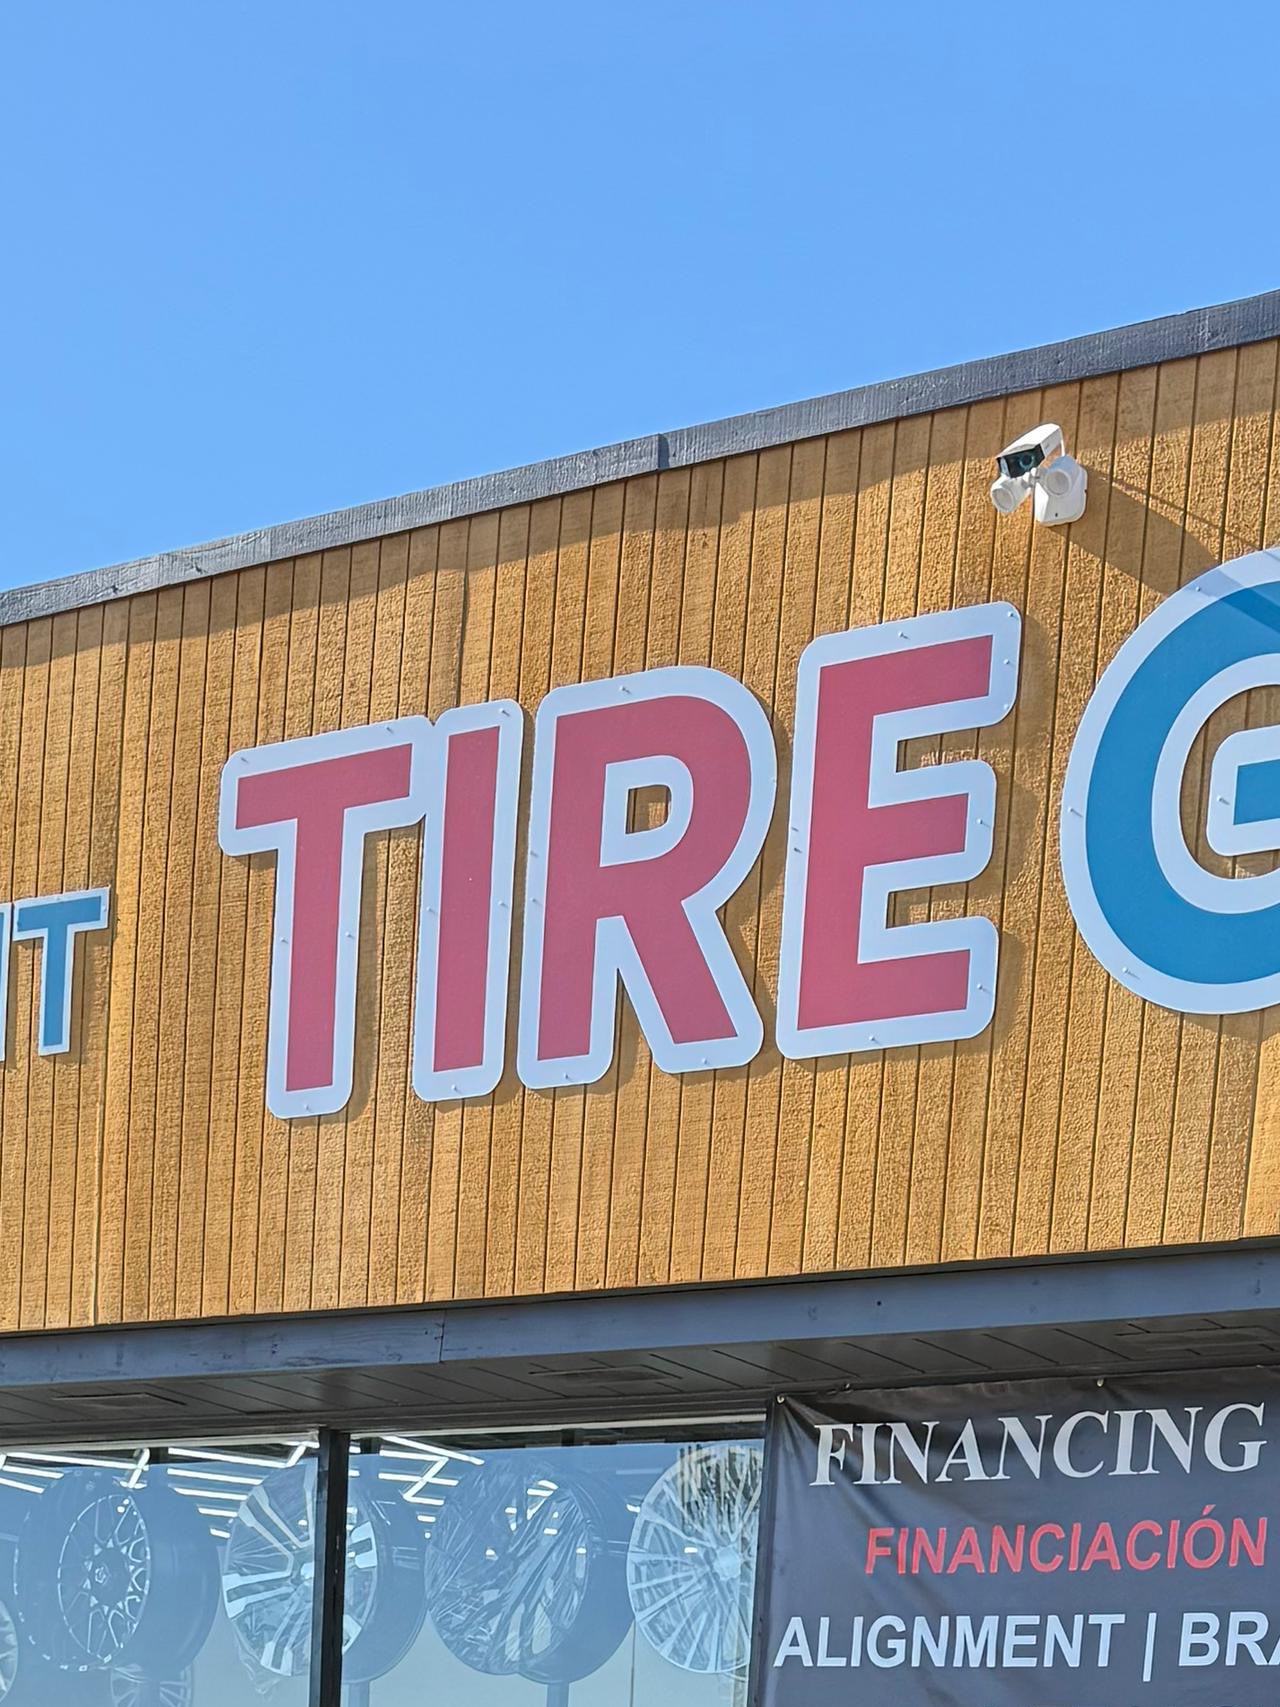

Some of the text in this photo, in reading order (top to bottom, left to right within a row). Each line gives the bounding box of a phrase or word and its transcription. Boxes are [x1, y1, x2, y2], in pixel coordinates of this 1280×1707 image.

[219, 599, 1024, 1120] TIRE
[811, 1401, 1266, 1488] FINANCING
[864, 1505, 1269, 1575] FINANCIACIÓN
[773, 1612, 1125, 1669] ALIGNMENT
